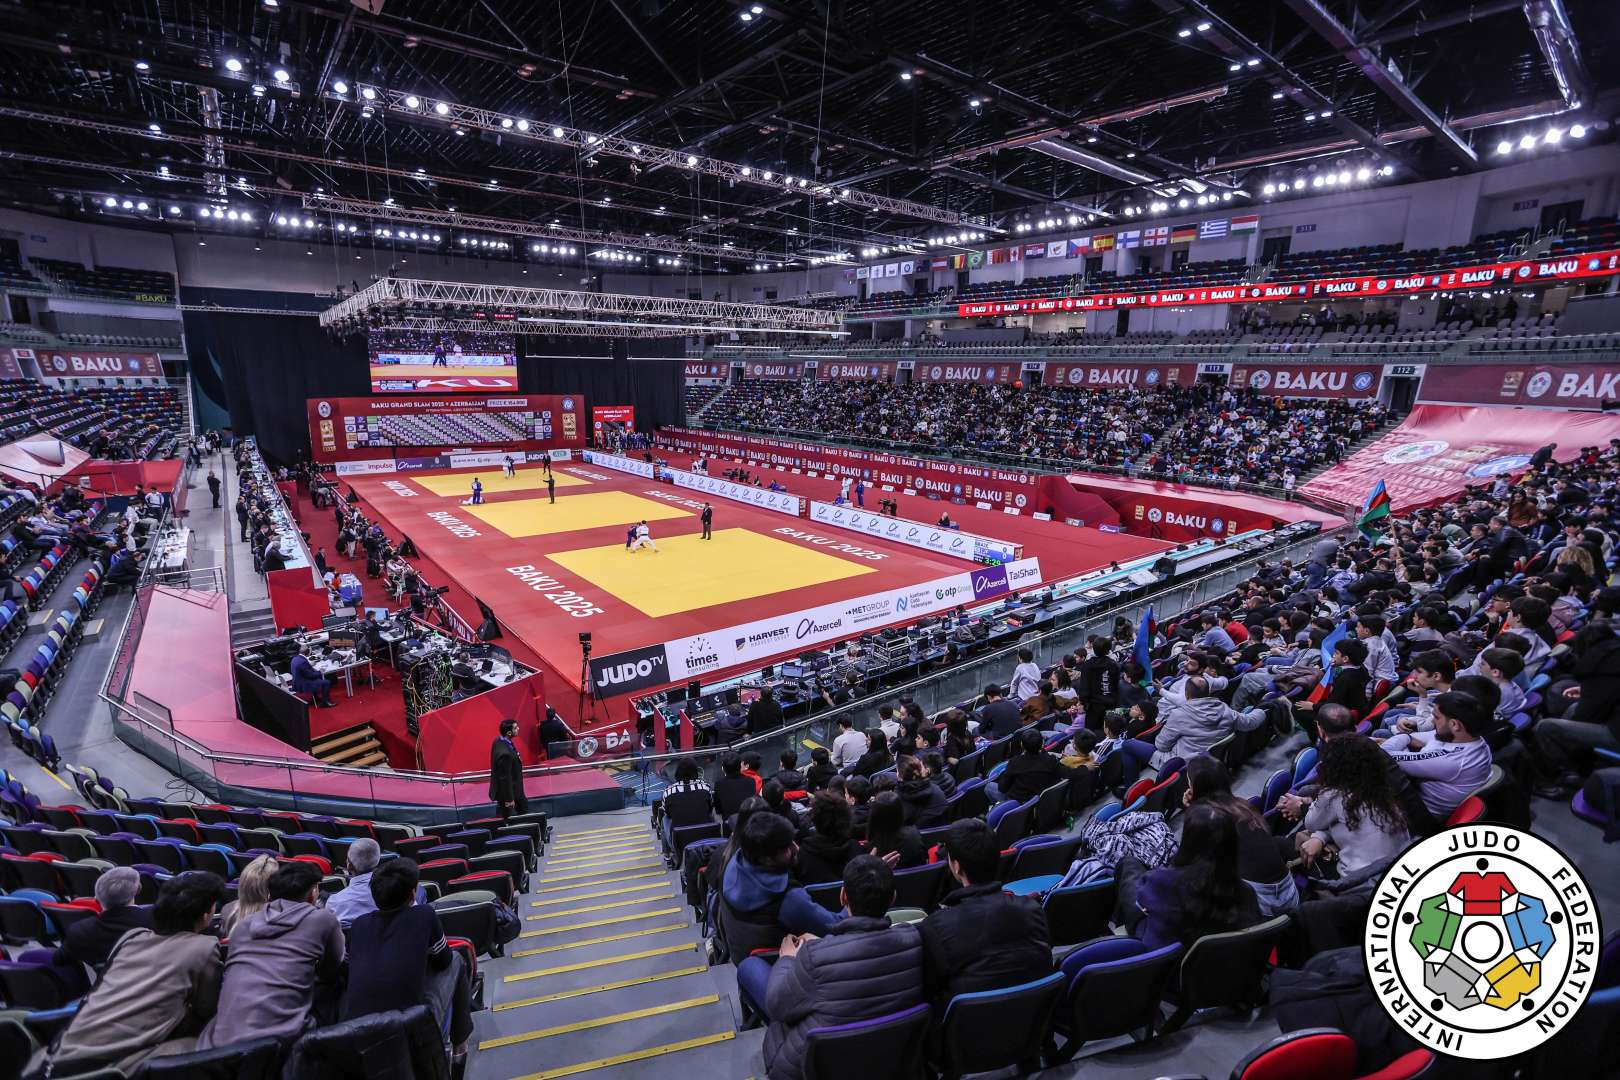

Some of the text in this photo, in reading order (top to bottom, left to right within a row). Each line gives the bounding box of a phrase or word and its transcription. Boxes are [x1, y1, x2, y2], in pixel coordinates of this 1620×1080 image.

[1539, 260, 1578, 276] BAKU
[1462, 270, 1496, 282] BAKU
[1326, 282, 1357, 293] BAKU
[1394, 278, 1425, 289] BAKU
[1211, 290, 1234, 300] BAKU
[1265, 286, 1293, 296] BAKU
[1162, 293, 1184, 302] BAKU
[70, 356, 122, 372] BAKU
[685, 366, 707, 375] AKU
[765, 366, 786, 376] BAKU
[841, 366, 868, 377] BAKU
[946, 367, 981, 380] BAKU
[1088, 368, 1139, 384] BAKU
[1274, 371, 1348, 390] BAKU
[1557, 373, 1620, 398] BAK
[726, 448, 739, 456] BAKU
[751, 452, 766, 460] BAKU
[778, 456, 794, 465] BAKU
[808, 461, 825, 470] BAKU
[841, 466, 860, 477] BAKU
[932, 464, 948, 472] BAKU
[964, 468, 981, 476] BAKU
[880, 473, 902, 484] BAKU
[998, 473, 1018, 482] BAKU
[926, 480, 950, 492] BAKU
[974, 488, 1002, 502] BAKU
[426, 512, 482, 538] BAKU 2025
[1166, 512, 1206, 528] BAKU
[772, 527, 888, 560] BAKU 2025
[1009, 568, 1038, 580] TaiShan
[987, 576, 1006, 589] Azercell
[506, 565, 605, 618] BAKU 2025
[945, 586, 956, 597] otp
[852, 600, 890, 614] METGROUP
[813, 618, 842, 634] Azercell
[749, 626, 790, 642] HARVEST
[686, 652, 718, 668] times
[597, 654, 664, 688] JUDO TV
[688, 662, 720, 674] consulting
